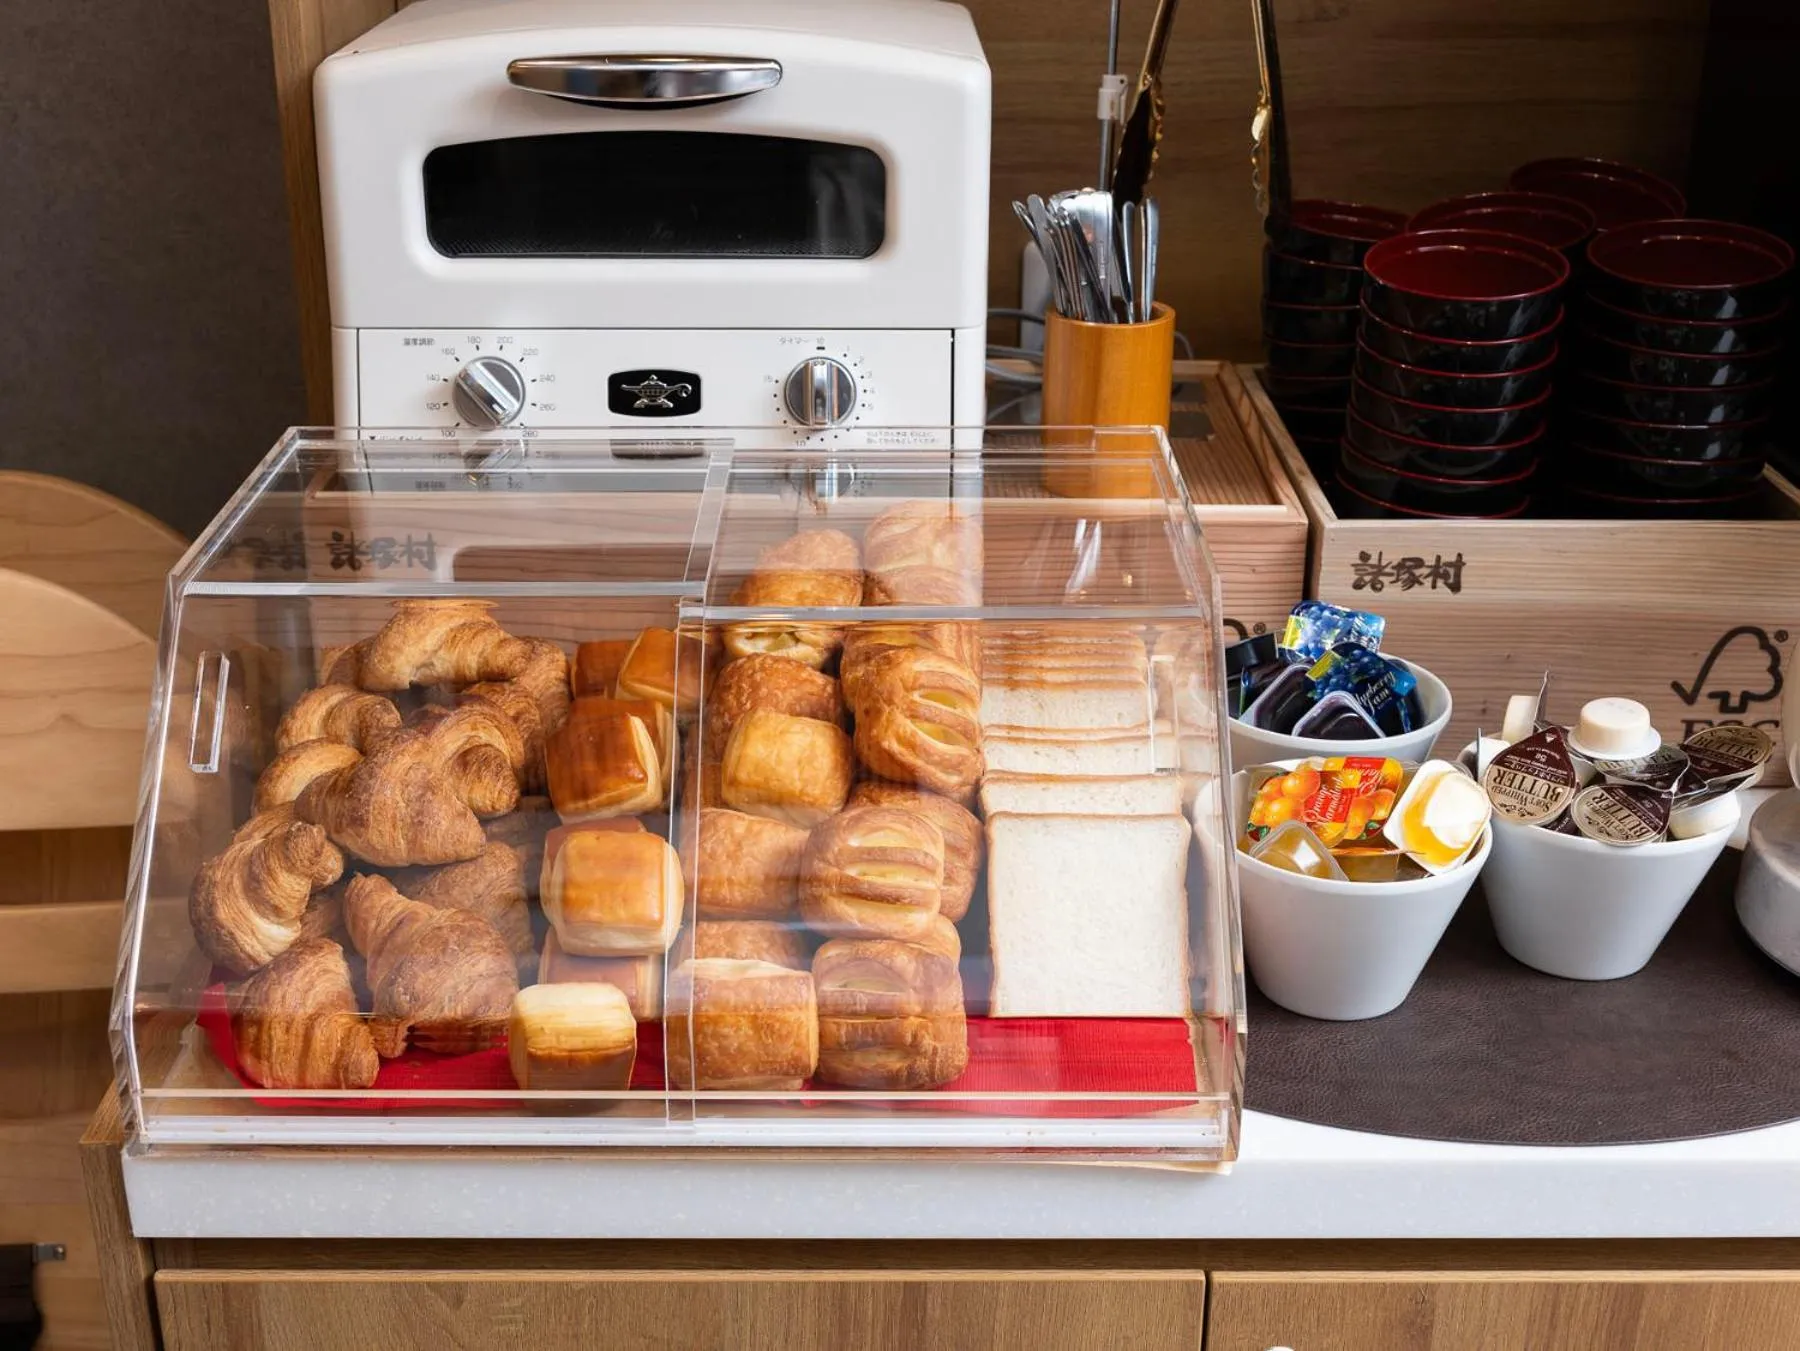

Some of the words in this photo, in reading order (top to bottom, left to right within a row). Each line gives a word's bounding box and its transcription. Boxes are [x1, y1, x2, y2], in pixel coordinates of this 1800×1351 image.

[1350, 550, 1467, 595] 諸塚村
[1493, 768, 1561, 802] BUTTER
[1591, 791, 1654, 838] BUTTER
